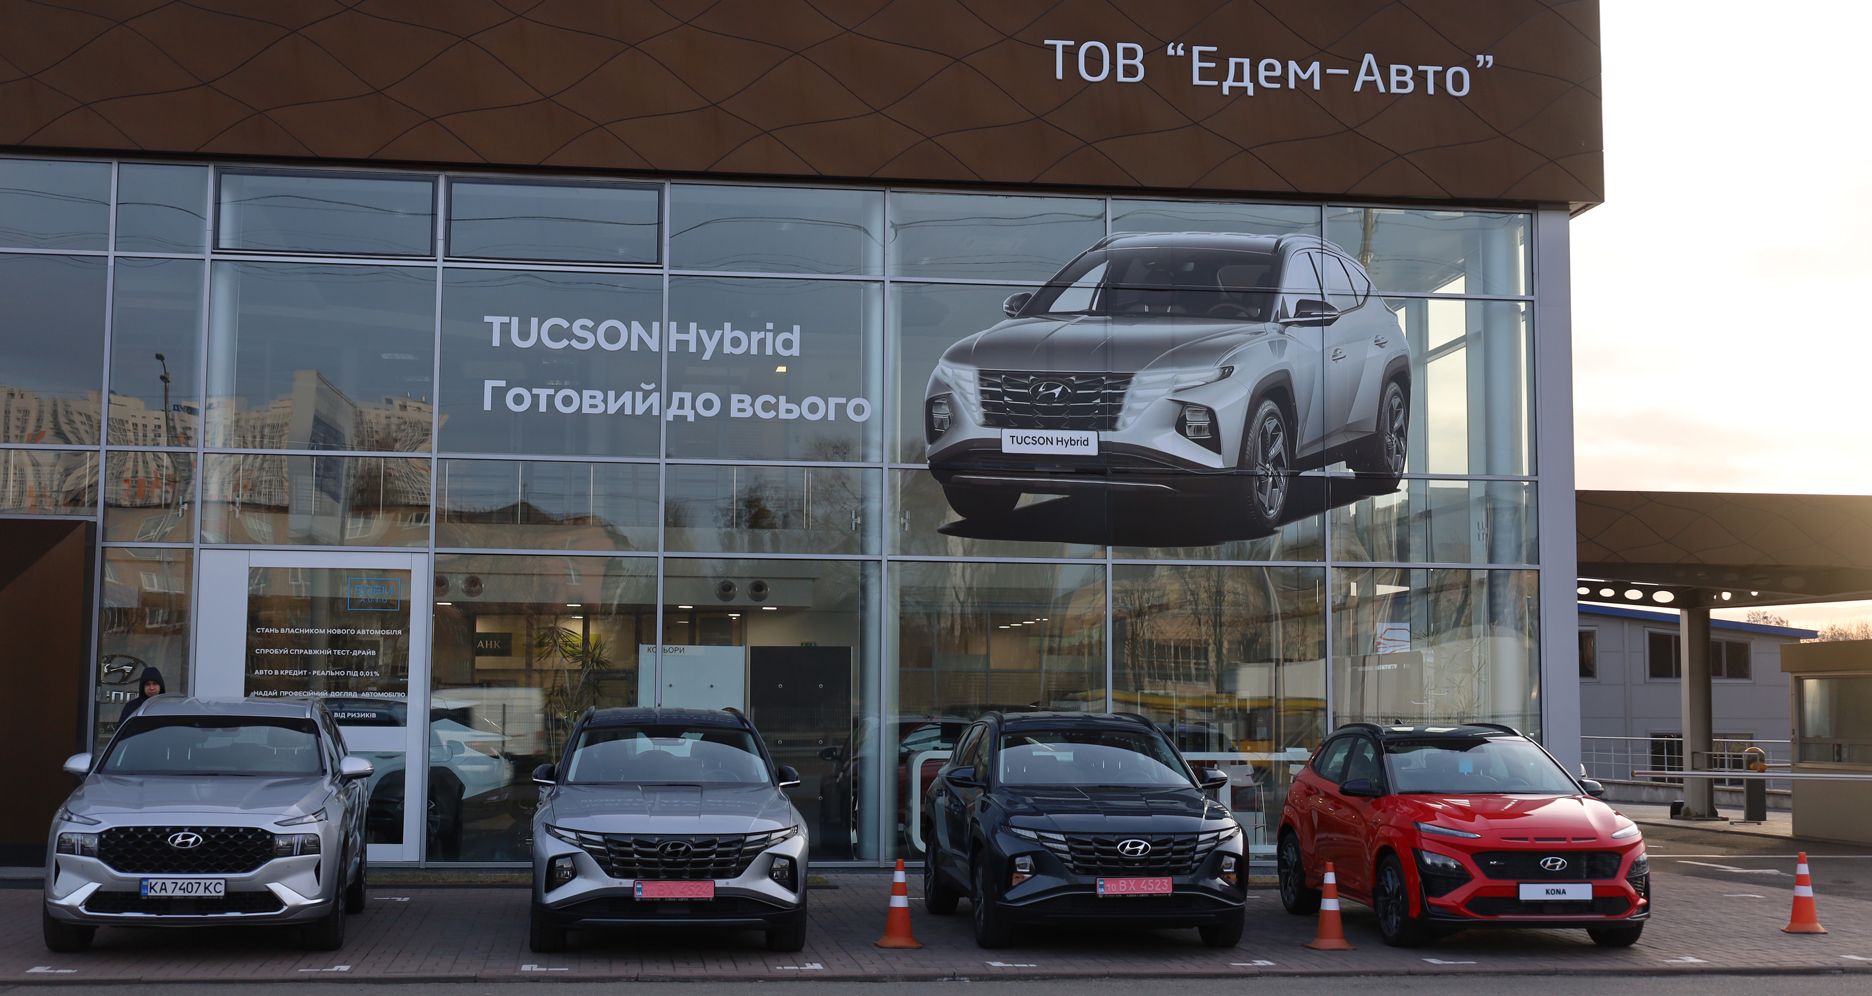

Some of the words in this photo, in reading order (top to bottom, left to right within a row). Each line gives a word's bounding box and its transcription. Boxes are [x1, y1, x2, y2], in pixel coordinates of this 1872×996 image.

[1044, 39, 1145, 83] ТОВ
[484, 315, 660, 352] TUCSON
[669, 321, 800, 361] Hybrid
[483, 379, 660, 416] Готовий
[666, 391, 721, 422] до
[730, 393, 871, 422] всього
[1009, 435, 1053, 446] TUCSON
[1056, 436, 1089, 448] Hybrid
[355, 585, 394, 596] EDEM
[280, 627, 325, 635] ВЛАСНИКОМ
[255, 647, 289, 655] СПРОБУЙ
[289, 648, 332, 656] СПРАВЖНІЙ
[333, 648, 376, 656] ТЕСТ-ДРАЙВ
[647, 646, 685, 654] КОЬОРИ
[280, 669, 308, 677] КРЕДИТ
[253, 689, 278, 697] НАДАЙ
[279, 689, 328, 697] ПРОФЕСІЙНИЙ
[149, 882, 168, 894] KA
[171, 881, 201, 894] 7407
[203, 881, 223, 894] KC
[1106, 883, 1117, 892] 10
[1119, 879, 1136, 892] BX
[1140, 879, 1168, 891] 4523
